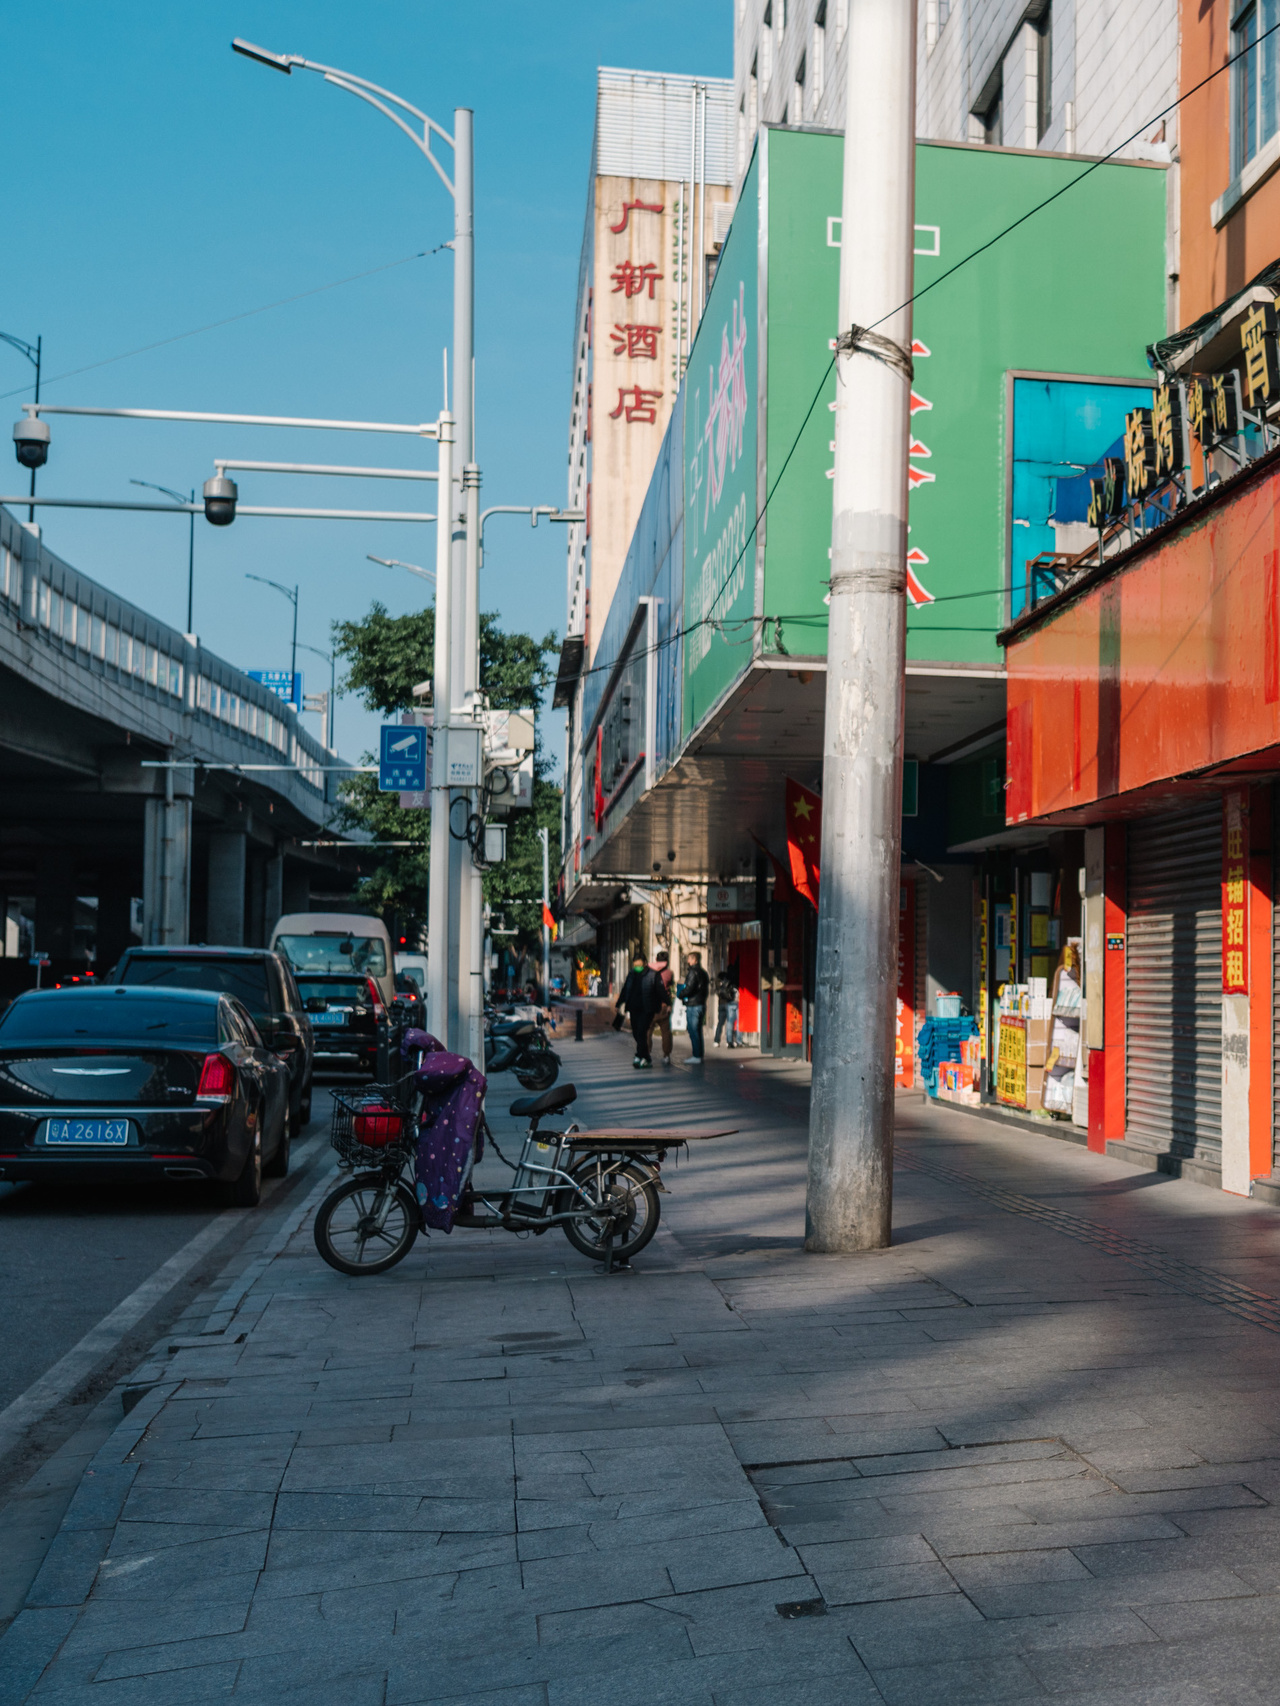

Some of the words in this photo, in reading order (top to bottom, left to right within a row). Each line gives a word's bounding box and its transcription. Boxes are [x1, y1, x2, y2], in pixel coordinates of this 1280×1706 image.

[608, 199, 664, 425] 广新酒店
[1227, 796, 1245, 986] 旺铺招租
